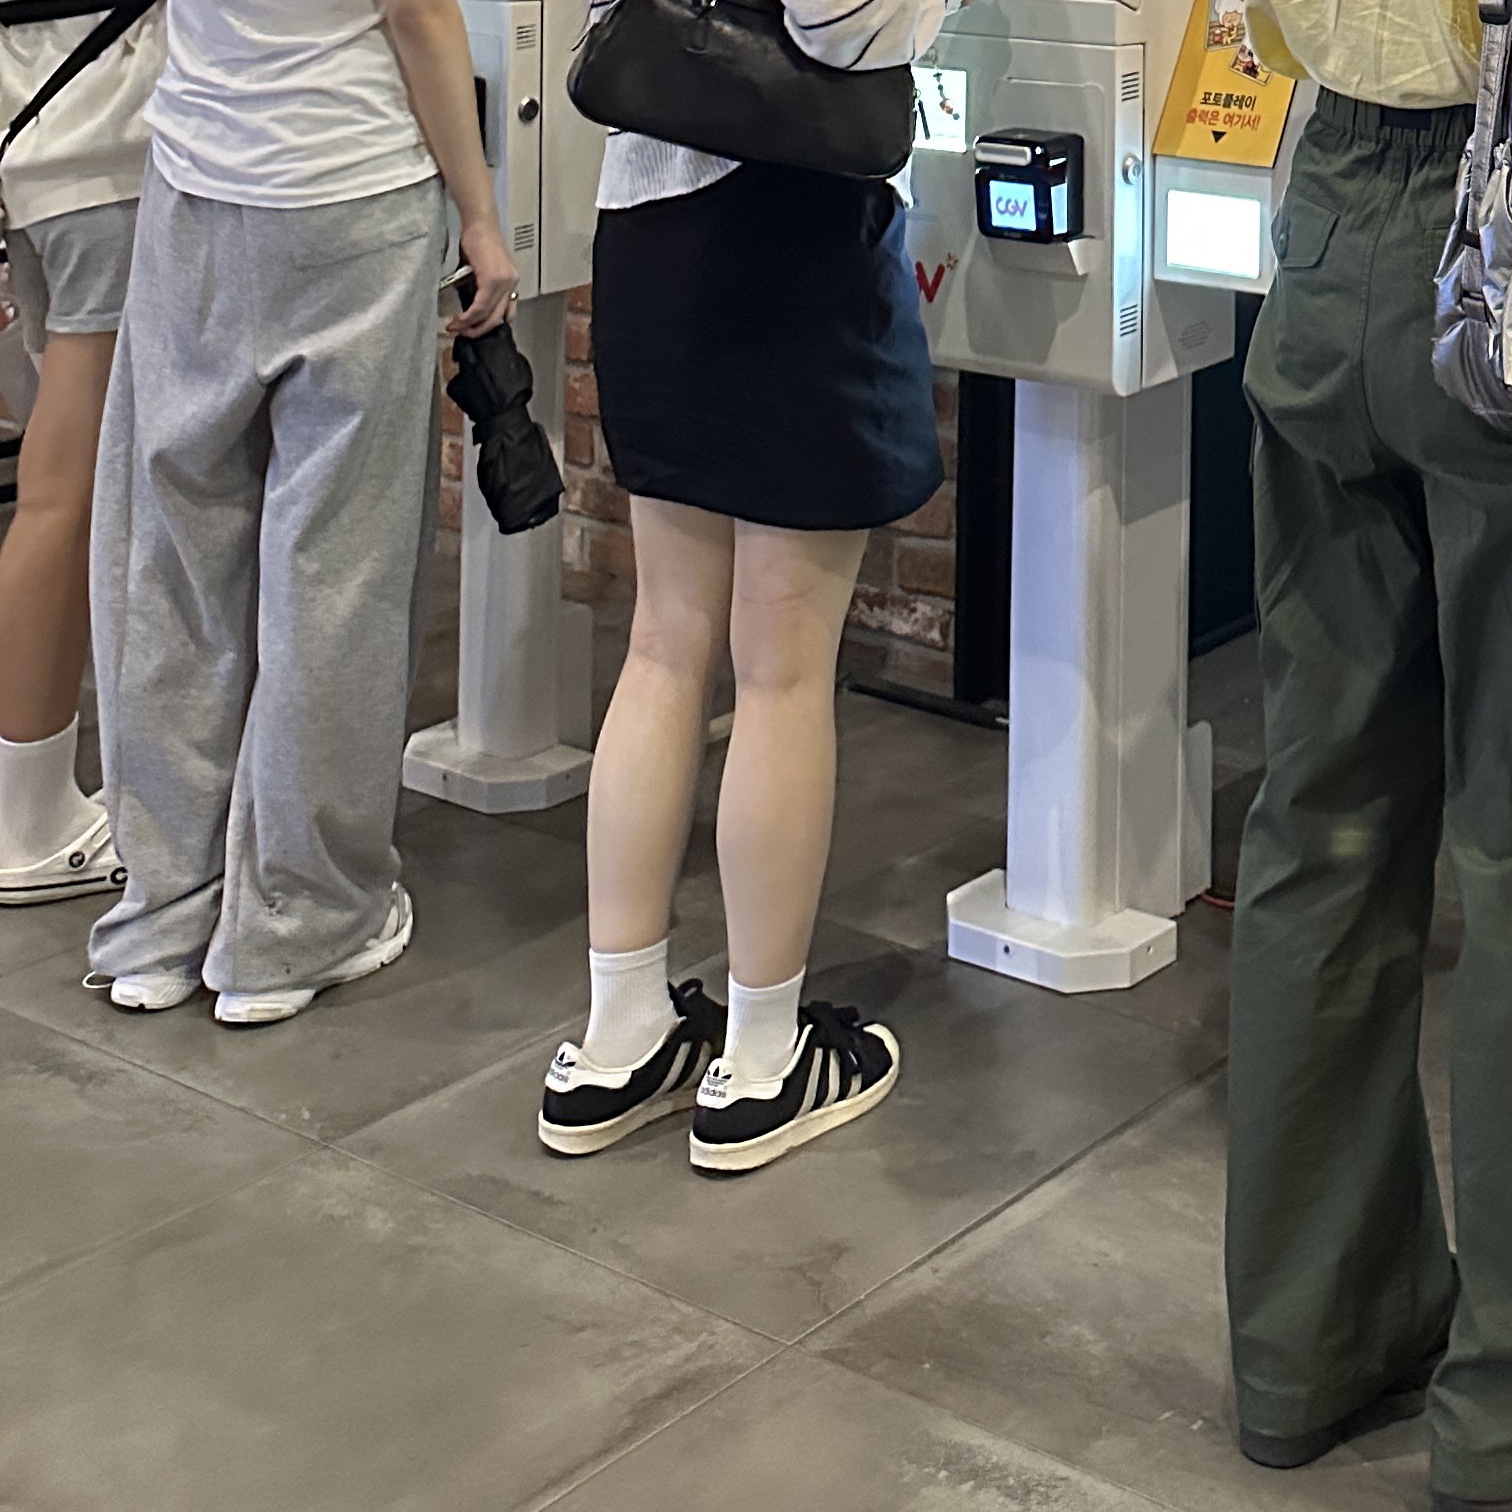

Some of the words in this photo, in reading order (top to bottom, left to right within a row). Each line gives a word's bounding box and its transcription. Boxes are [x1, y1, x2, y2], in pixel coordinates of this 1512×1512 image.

[1200, 91, 1257, 111] 포토플레이
[1185, 109, 1219, 128] 출력은
[1222, 113, 1261, 131] 여기서!
[995, 196, 1028, 218] CGV
